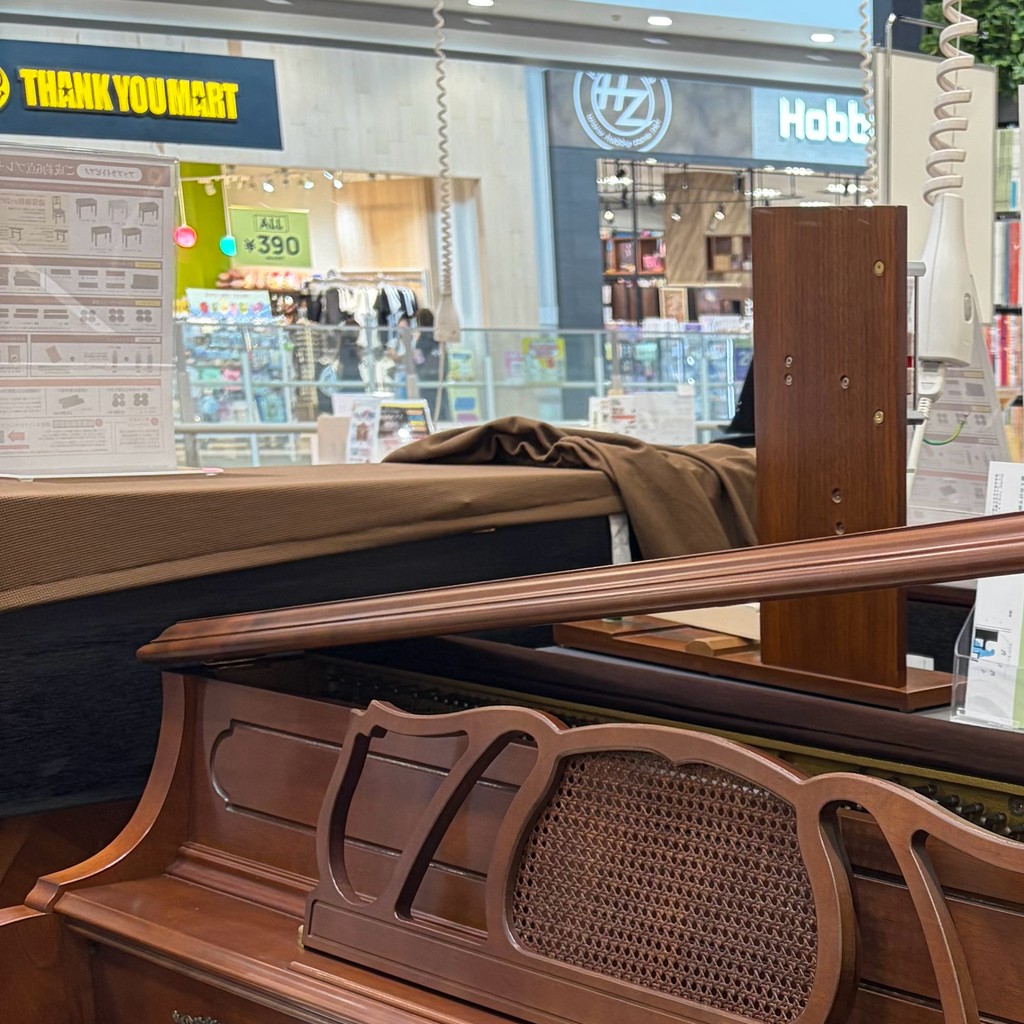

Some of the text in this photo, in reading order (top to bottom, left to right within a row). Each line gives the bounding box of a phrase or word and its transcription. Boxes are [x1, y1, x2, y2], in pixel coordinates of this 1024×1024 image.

[19, 68, 239, 121] THANK YOU MART
[244, 235, 300, 256] ¥390
